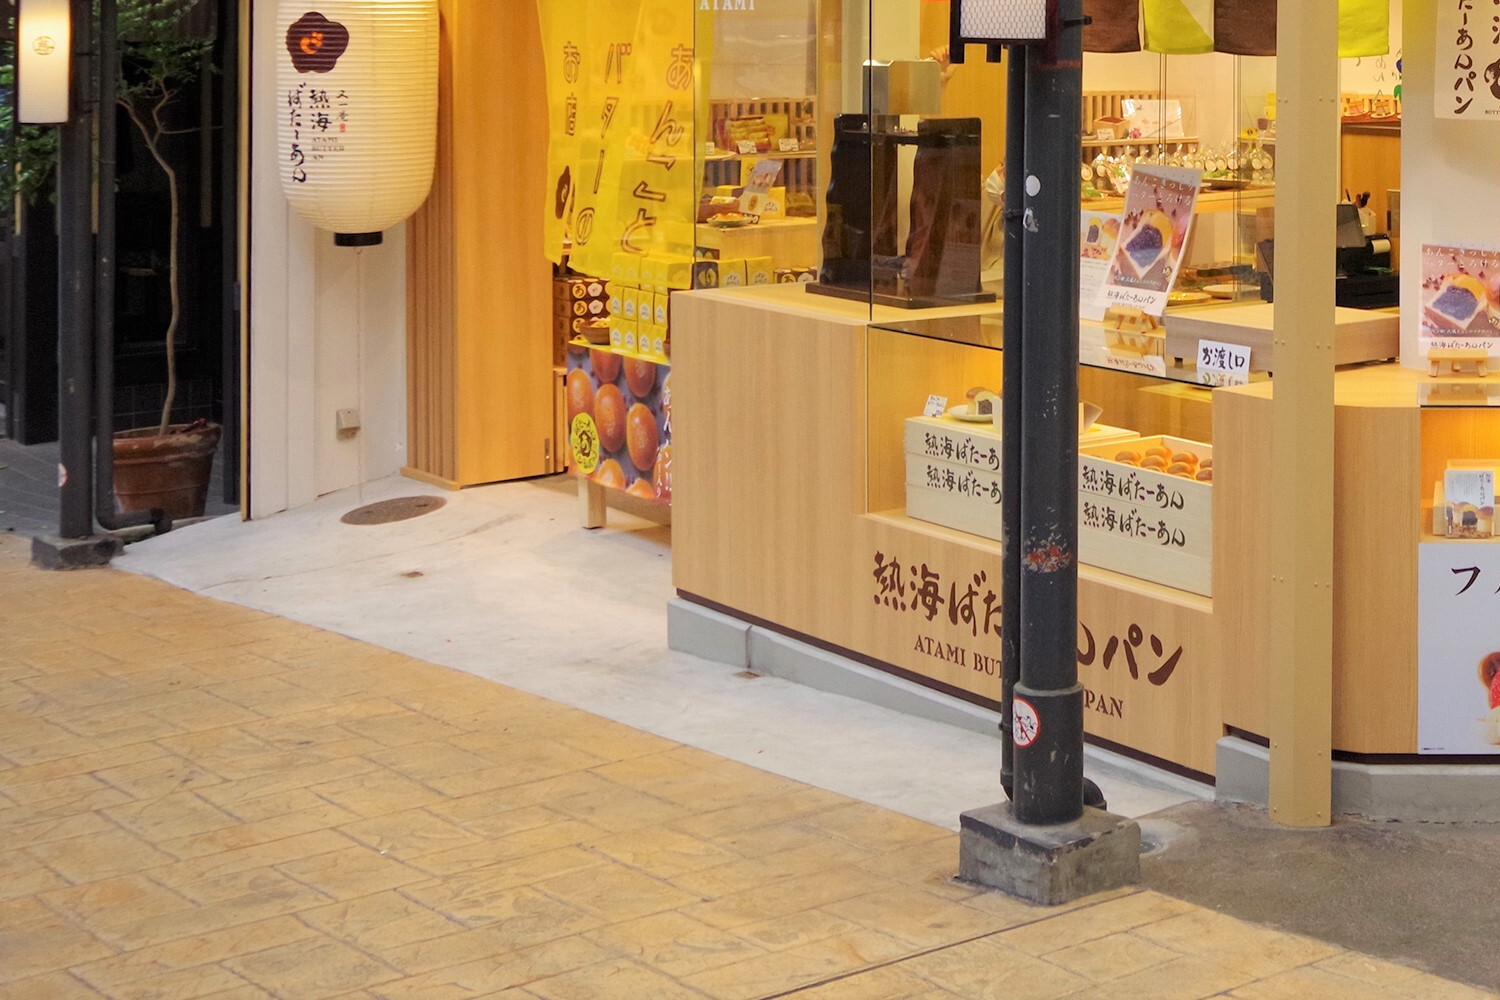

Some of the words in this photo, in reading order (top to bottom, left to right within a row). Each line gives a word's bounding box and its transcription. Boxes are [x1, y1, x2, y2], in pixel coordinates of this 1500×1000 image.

[574, 42, 633, 246] バターの
[620, 43, 695, 256] あんこと
[924, 432, 1000, 471] 熱海ばたーあ
[926, 464, 1002, 504] 熱海ばたーあ
[1082, 465, 1184, 510] 熱海ばたーあん
[1083, 501, 1186, 547] 熱海ばたーあん
[913, 634, 966, 668] ATAMI
[973, 653, 1002, 679] BUT
[1084, 688, 1124, 719] PAN
